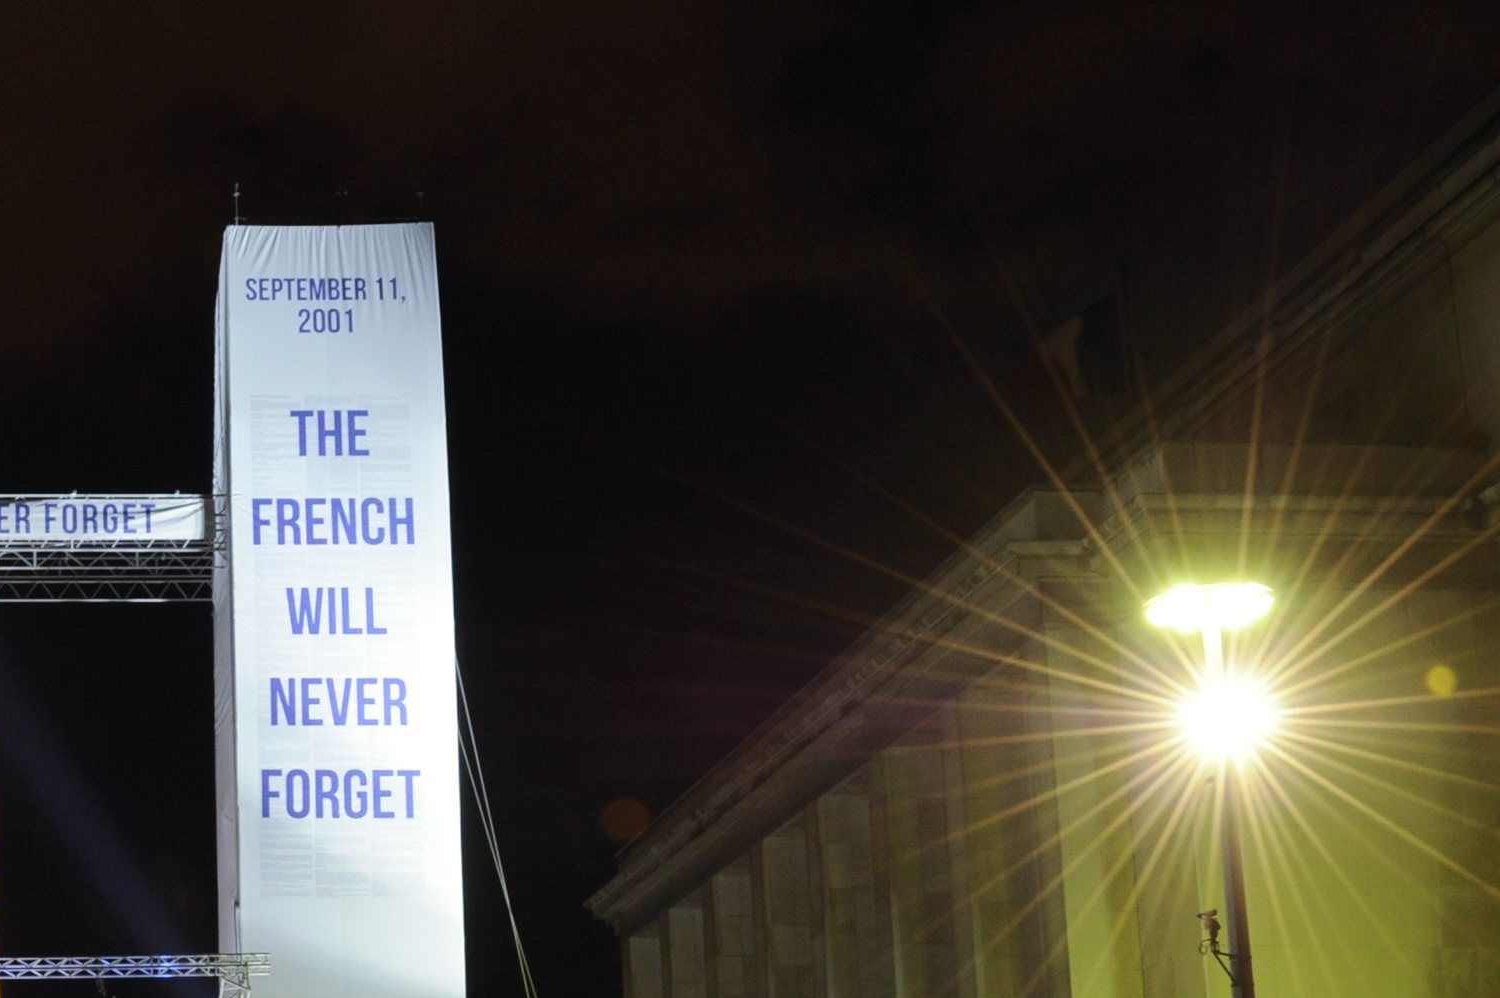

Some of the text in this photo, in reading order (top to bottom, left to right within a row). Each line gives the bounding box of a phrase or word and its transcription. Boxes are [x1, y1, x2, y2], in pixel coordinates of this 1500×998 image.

[245, 278, 406, 304] SEPTEMBER 11,
[298, 308, 354, 334] 2001
[289, 409, 370, 457] THE
[44, 503, 157, 534] FORGET
[251, 497, 416, 546] FRENCH
[285, 587, 388, 635] WILL
[269, 677, 408, 727] NEVER
[260, 768, 421, 820] FORGET
